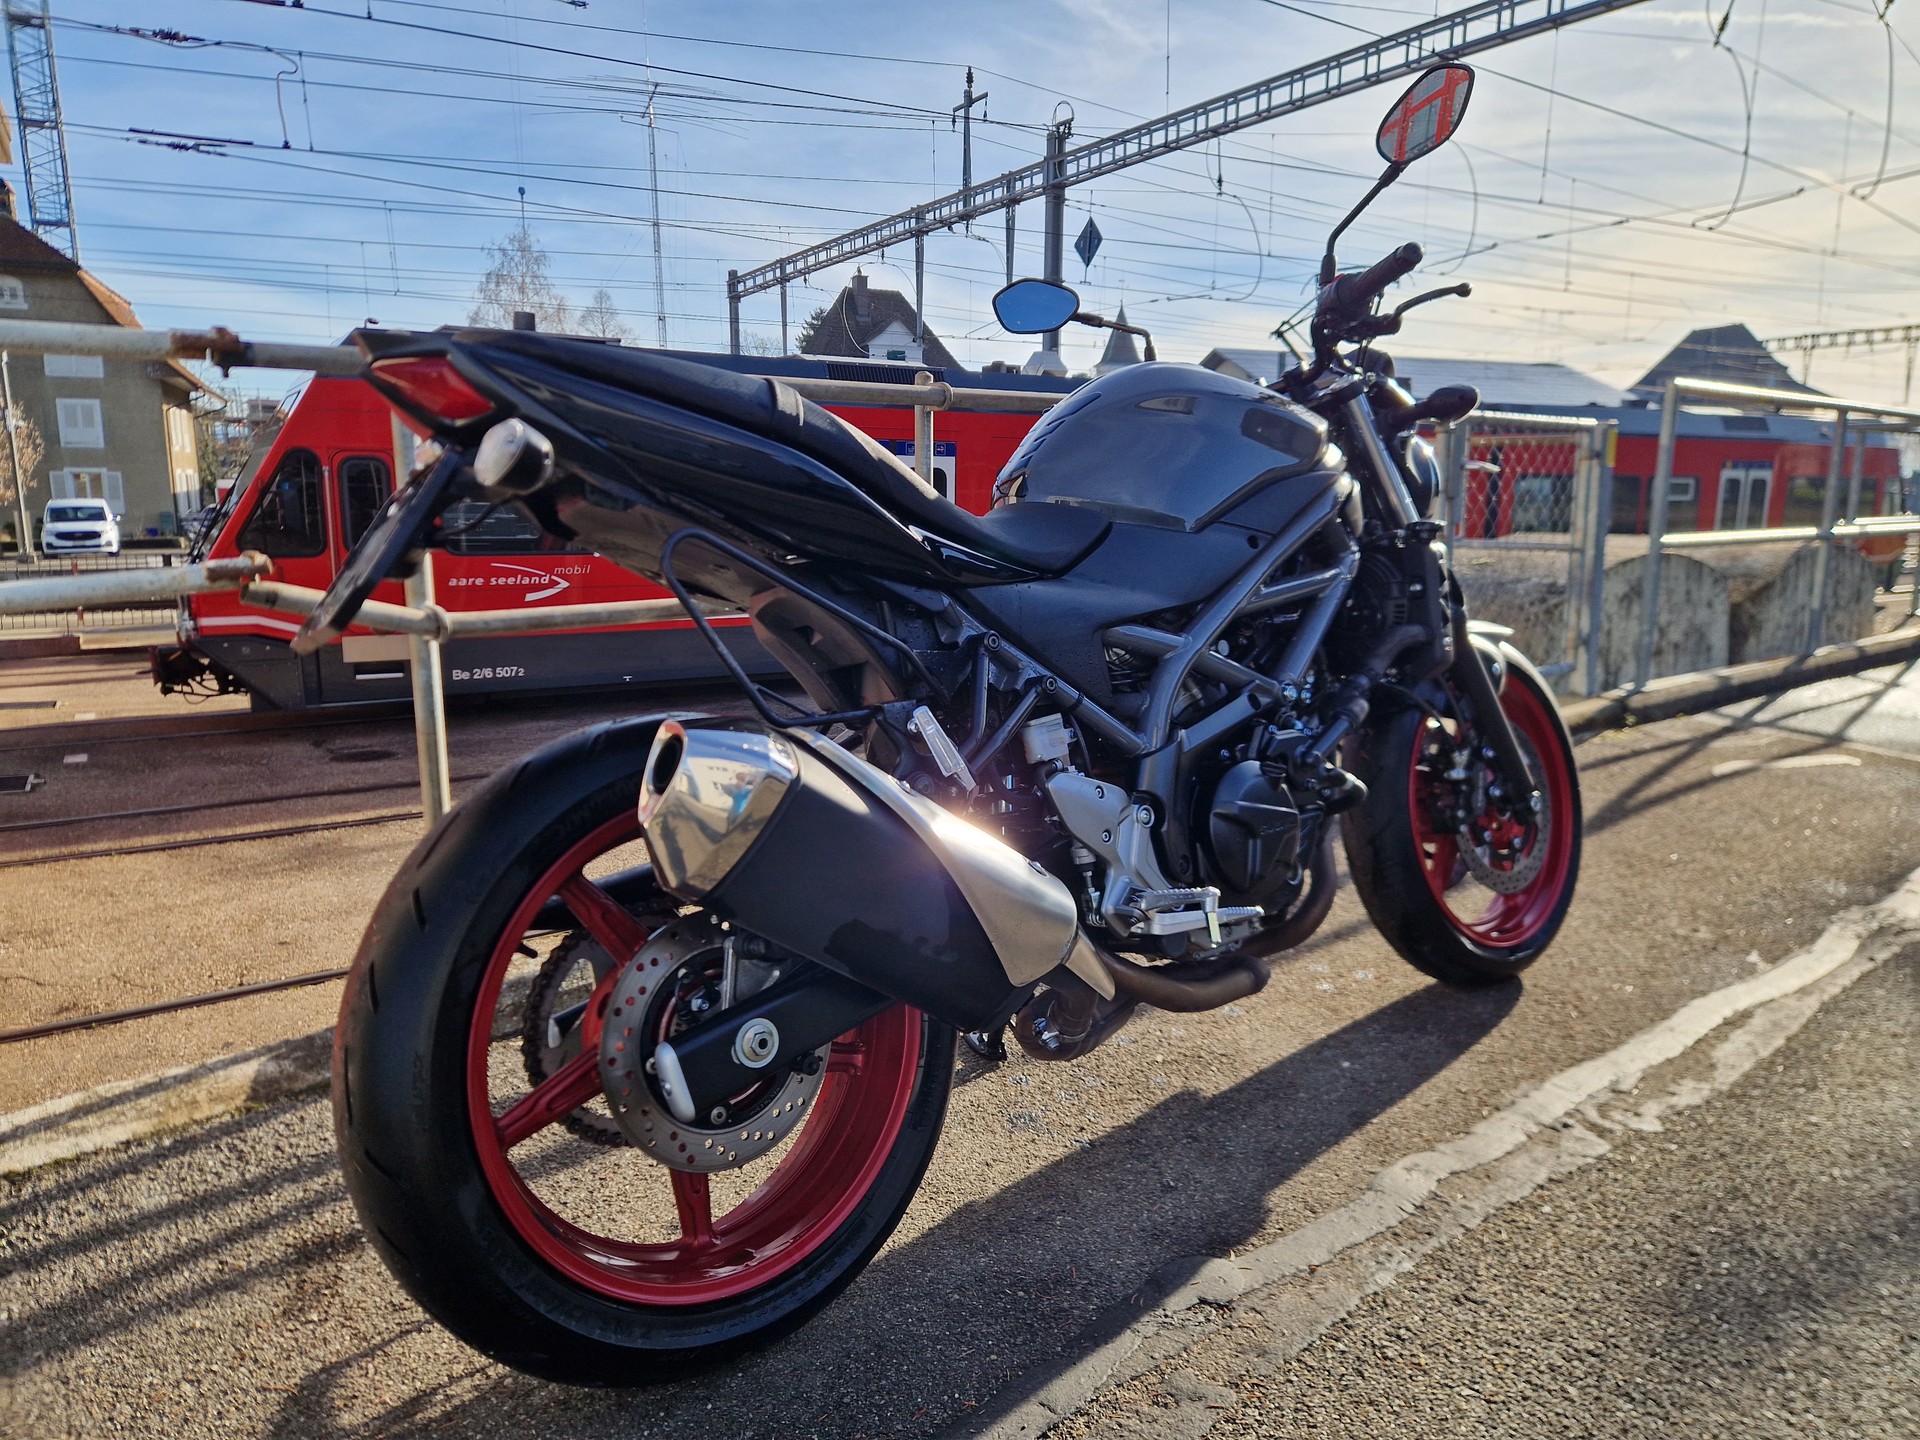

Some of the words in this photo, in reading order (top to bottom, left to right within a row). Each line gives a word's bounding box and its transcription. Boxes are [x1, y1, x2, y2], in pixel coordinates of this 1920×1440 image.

[448, 577, 485, 587] aare
[489, 574, 550, 586] seeland
[553, 564, 591, 575] mobil
[452, 669, 471, 681] Be
[472, 667, 493, 680] 2/6
